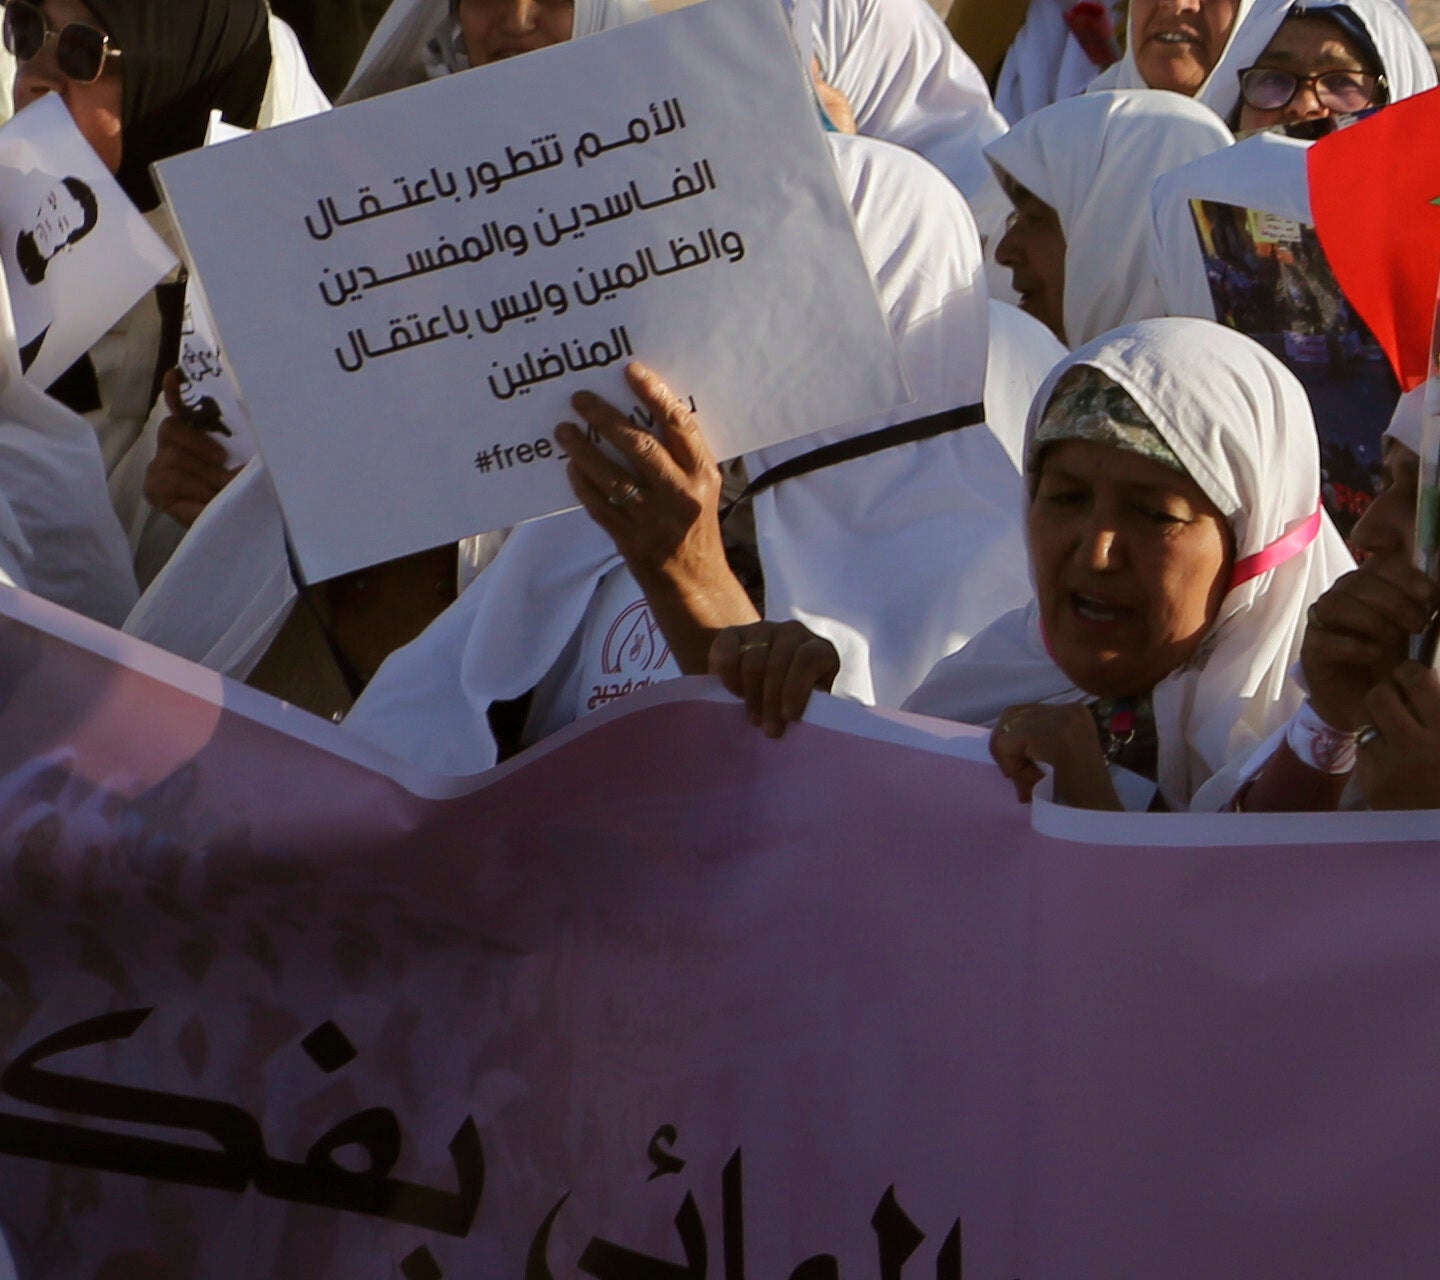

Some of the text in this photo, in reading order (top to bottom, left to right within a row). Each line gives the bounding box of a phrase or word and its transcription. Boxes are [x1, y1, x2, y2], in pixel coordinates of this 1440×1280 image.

[304, 97, 687, 241] الأمم تتطور باعتقال
[318, 158, 716, 308] الفاسدين والمفسدين
[334, 227, 745, 373] والظالمين وليس باعتقال
[487, 325, 634, 401] المناضلين
